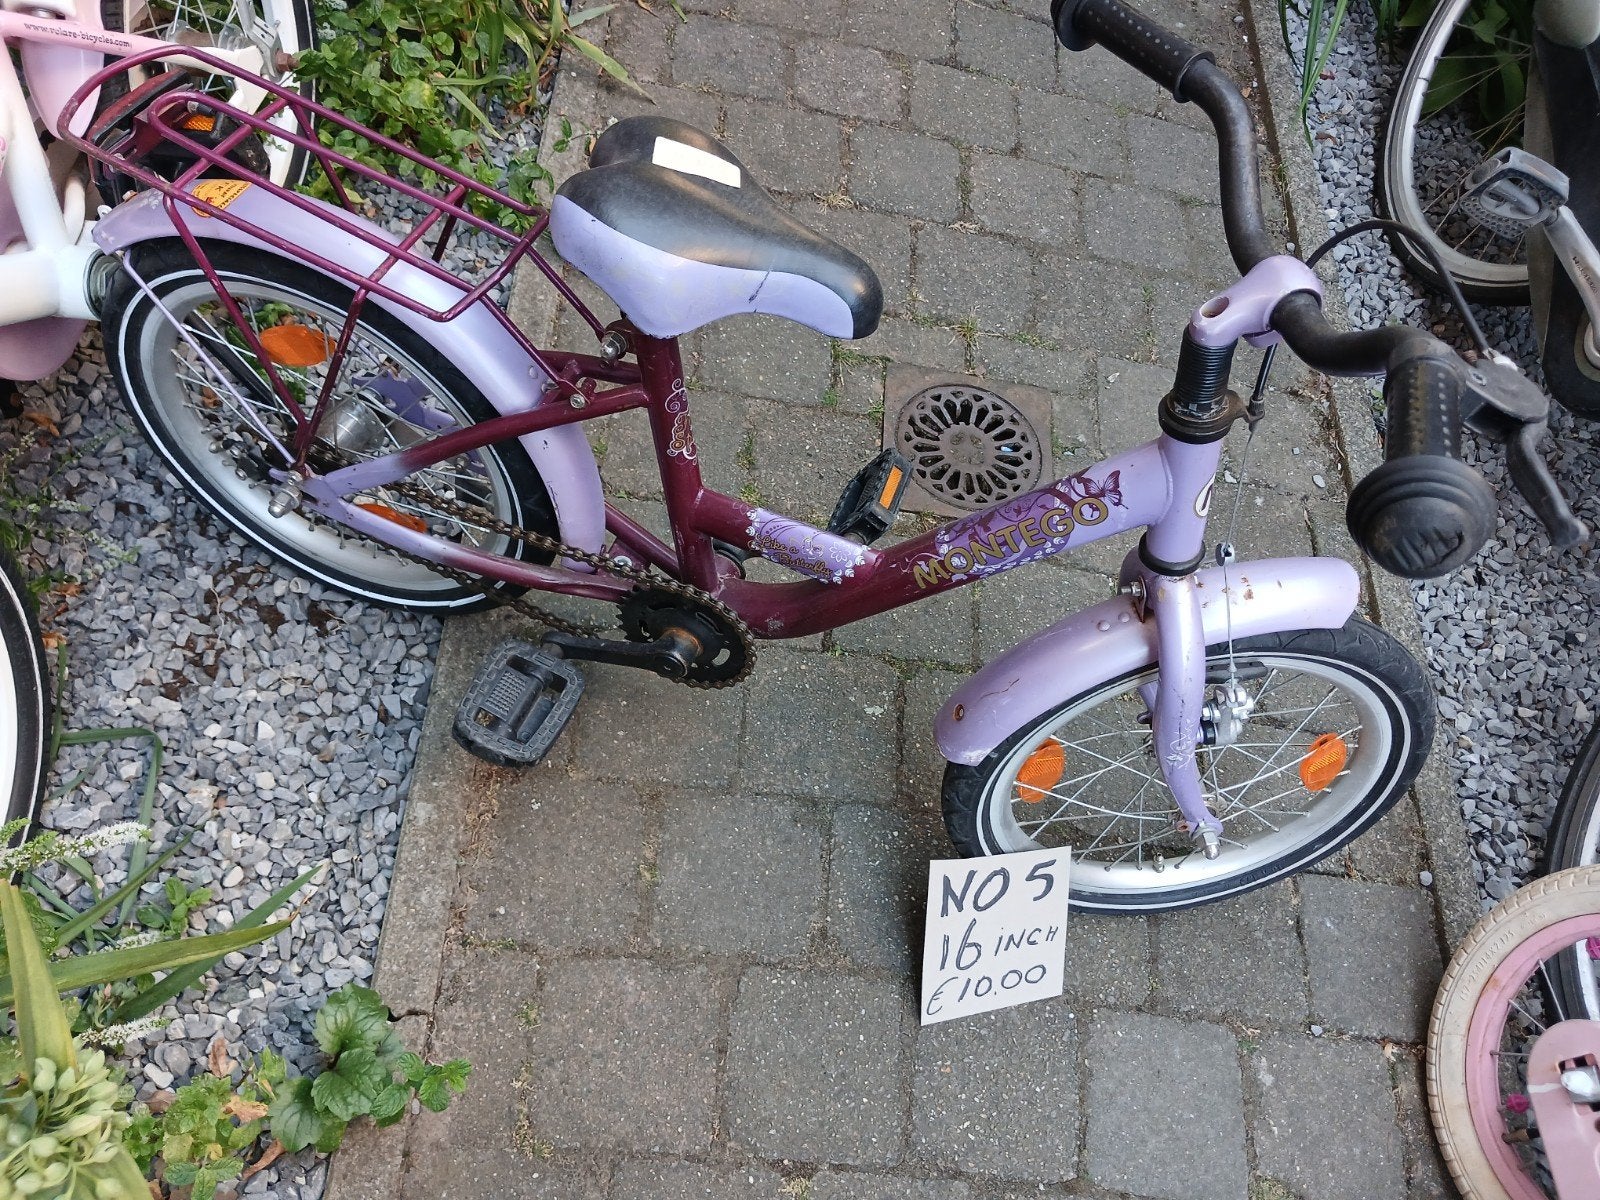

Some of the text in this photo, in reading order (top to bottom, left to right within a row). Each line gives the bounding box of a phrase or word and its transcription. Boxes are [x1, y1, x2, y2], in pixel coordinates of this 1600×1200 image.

[773, 551, 832, 579] Butterfly
[913, 497, 1109, 589] MONTEGO
[940, 859, 1057, 917] NO 5
[939, 917, 982, 971] 16
[926, 964, 1047, 1016] €10.00
